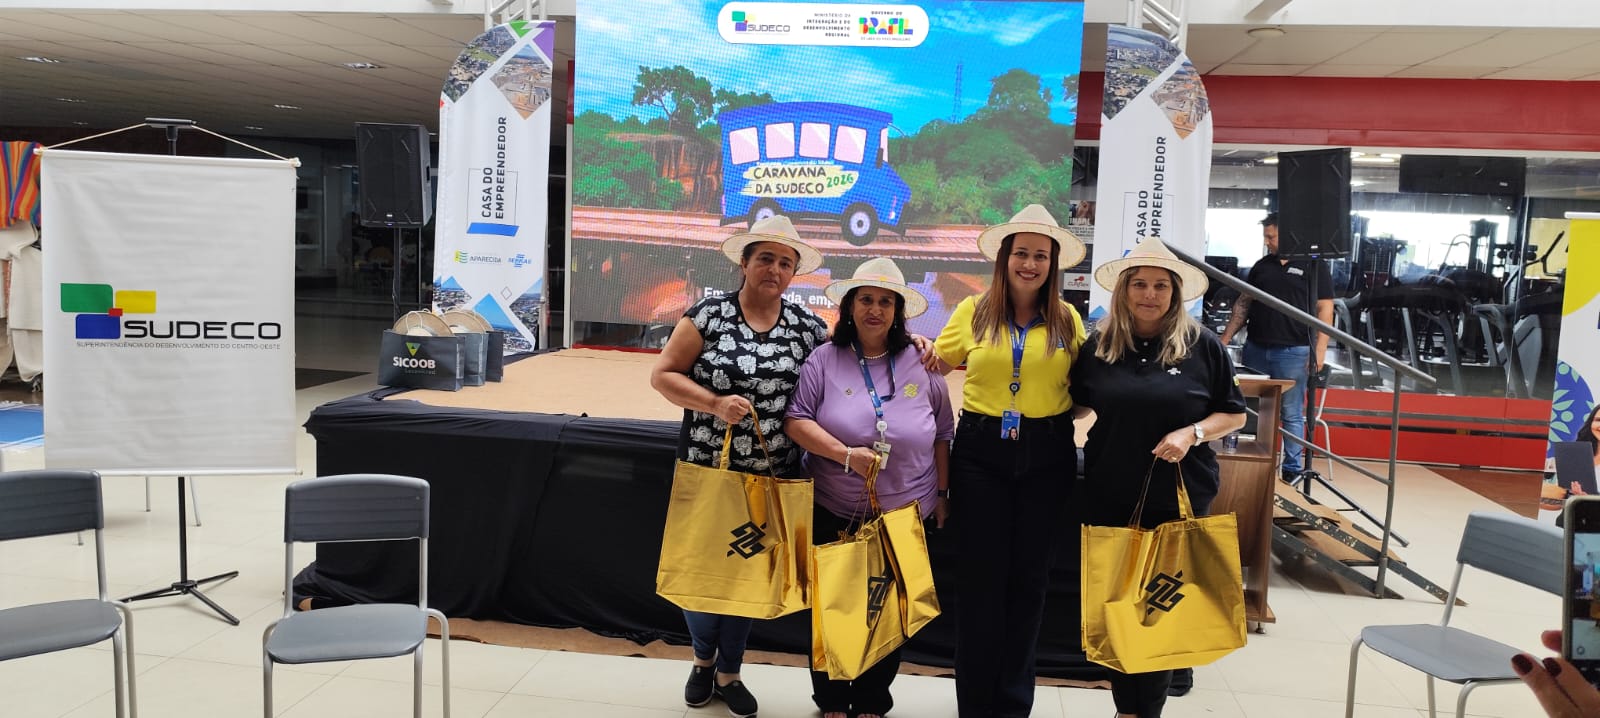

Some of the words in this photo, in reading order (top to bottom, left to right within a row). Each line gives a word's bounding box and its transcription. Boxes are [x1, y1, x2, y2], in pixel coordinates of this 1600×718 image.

[747, 23, 791, 33] SUDECO
[858, 17, 914, 35] BRASIL
[482, 167, 493, 184] DO
[495, 116, 507, 220] EMPREENDEDOR
[753, 166, 827, 179] CARAVANA
[755, 183, 772, 194] DA
[775, 182, 825, 194] SUDECO
[826, 173, 854, 188] 2026
[1150, 136, 1167, 239] MPREENDEDOR
[481, 187, 492, 218] CASA
[1137, 190, 1148, 208] DO
[124, 319, 281, 340] SUDECO
[76, 341, 144, 349] SUPERINTENDÊNCIA
[155, 342, 219, 350] DESENVOLVIMENTO
[392, 356, 436, 369] SICOOB
